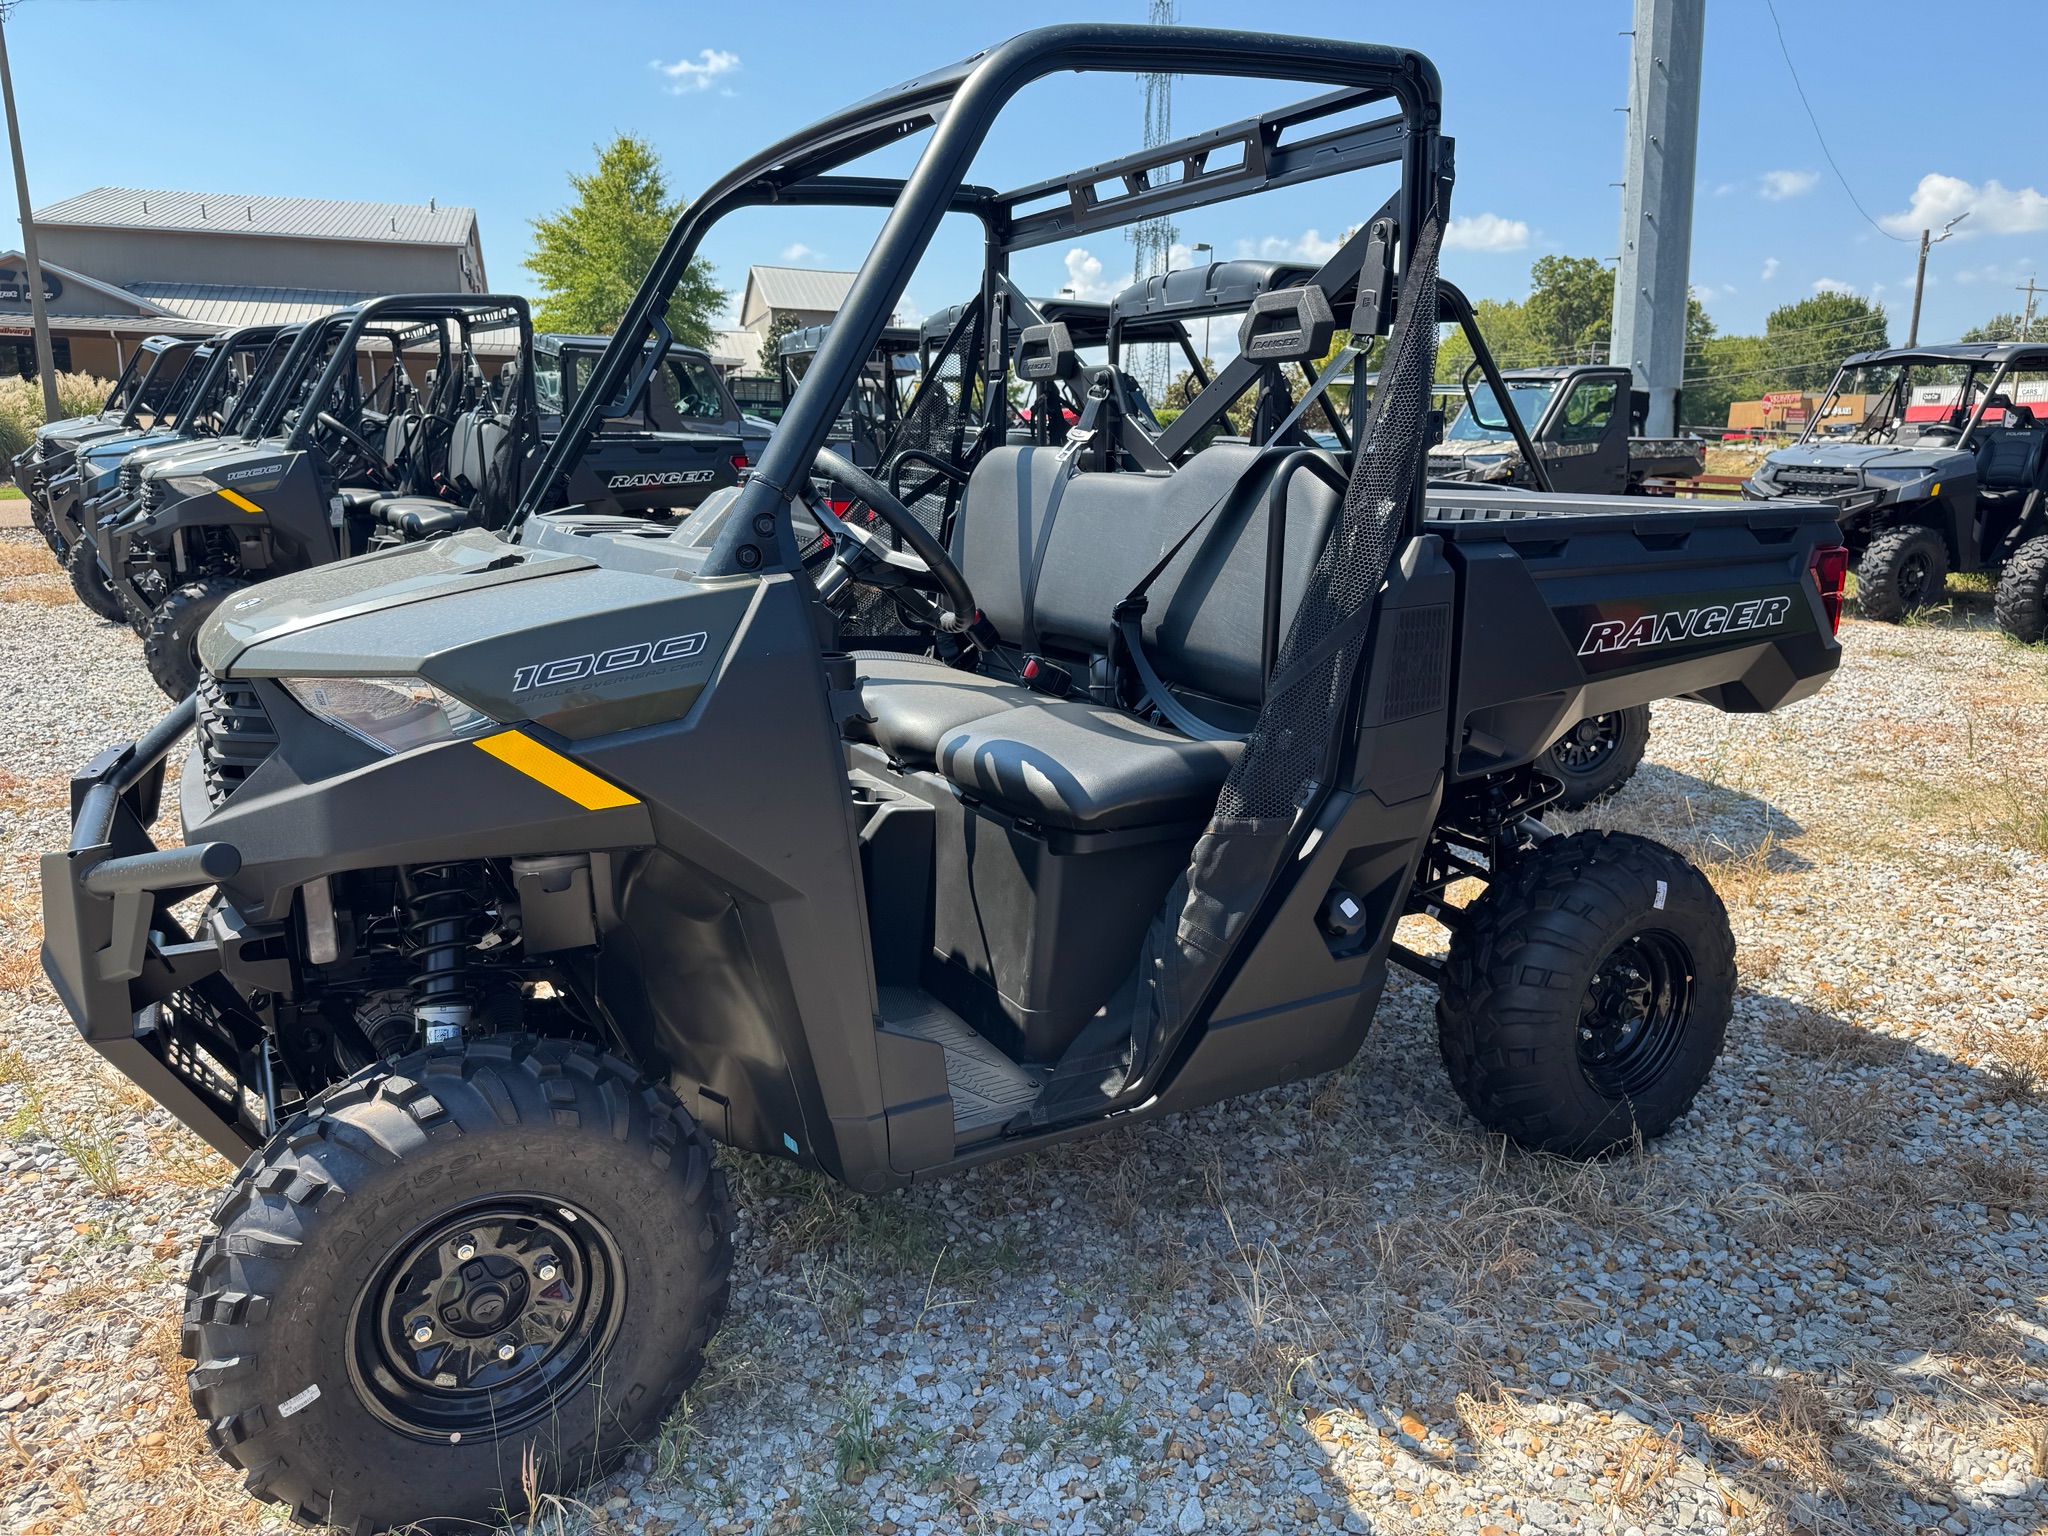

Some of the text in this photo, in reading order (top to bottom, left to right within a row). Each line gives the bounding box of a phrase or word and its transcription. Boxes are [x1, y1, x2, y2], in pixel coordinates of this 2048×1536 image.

[1253, 338, 1300, 350] RANGER
[227, 464, 282, 481] 1000
[607, 470, 715, 488] RANGER
[1577, 596, 1791, 656] RANGER
[512, 631, 708, 692] 1000
[515, 660, 704, 705] SINGLE OVERHEAD CAM
